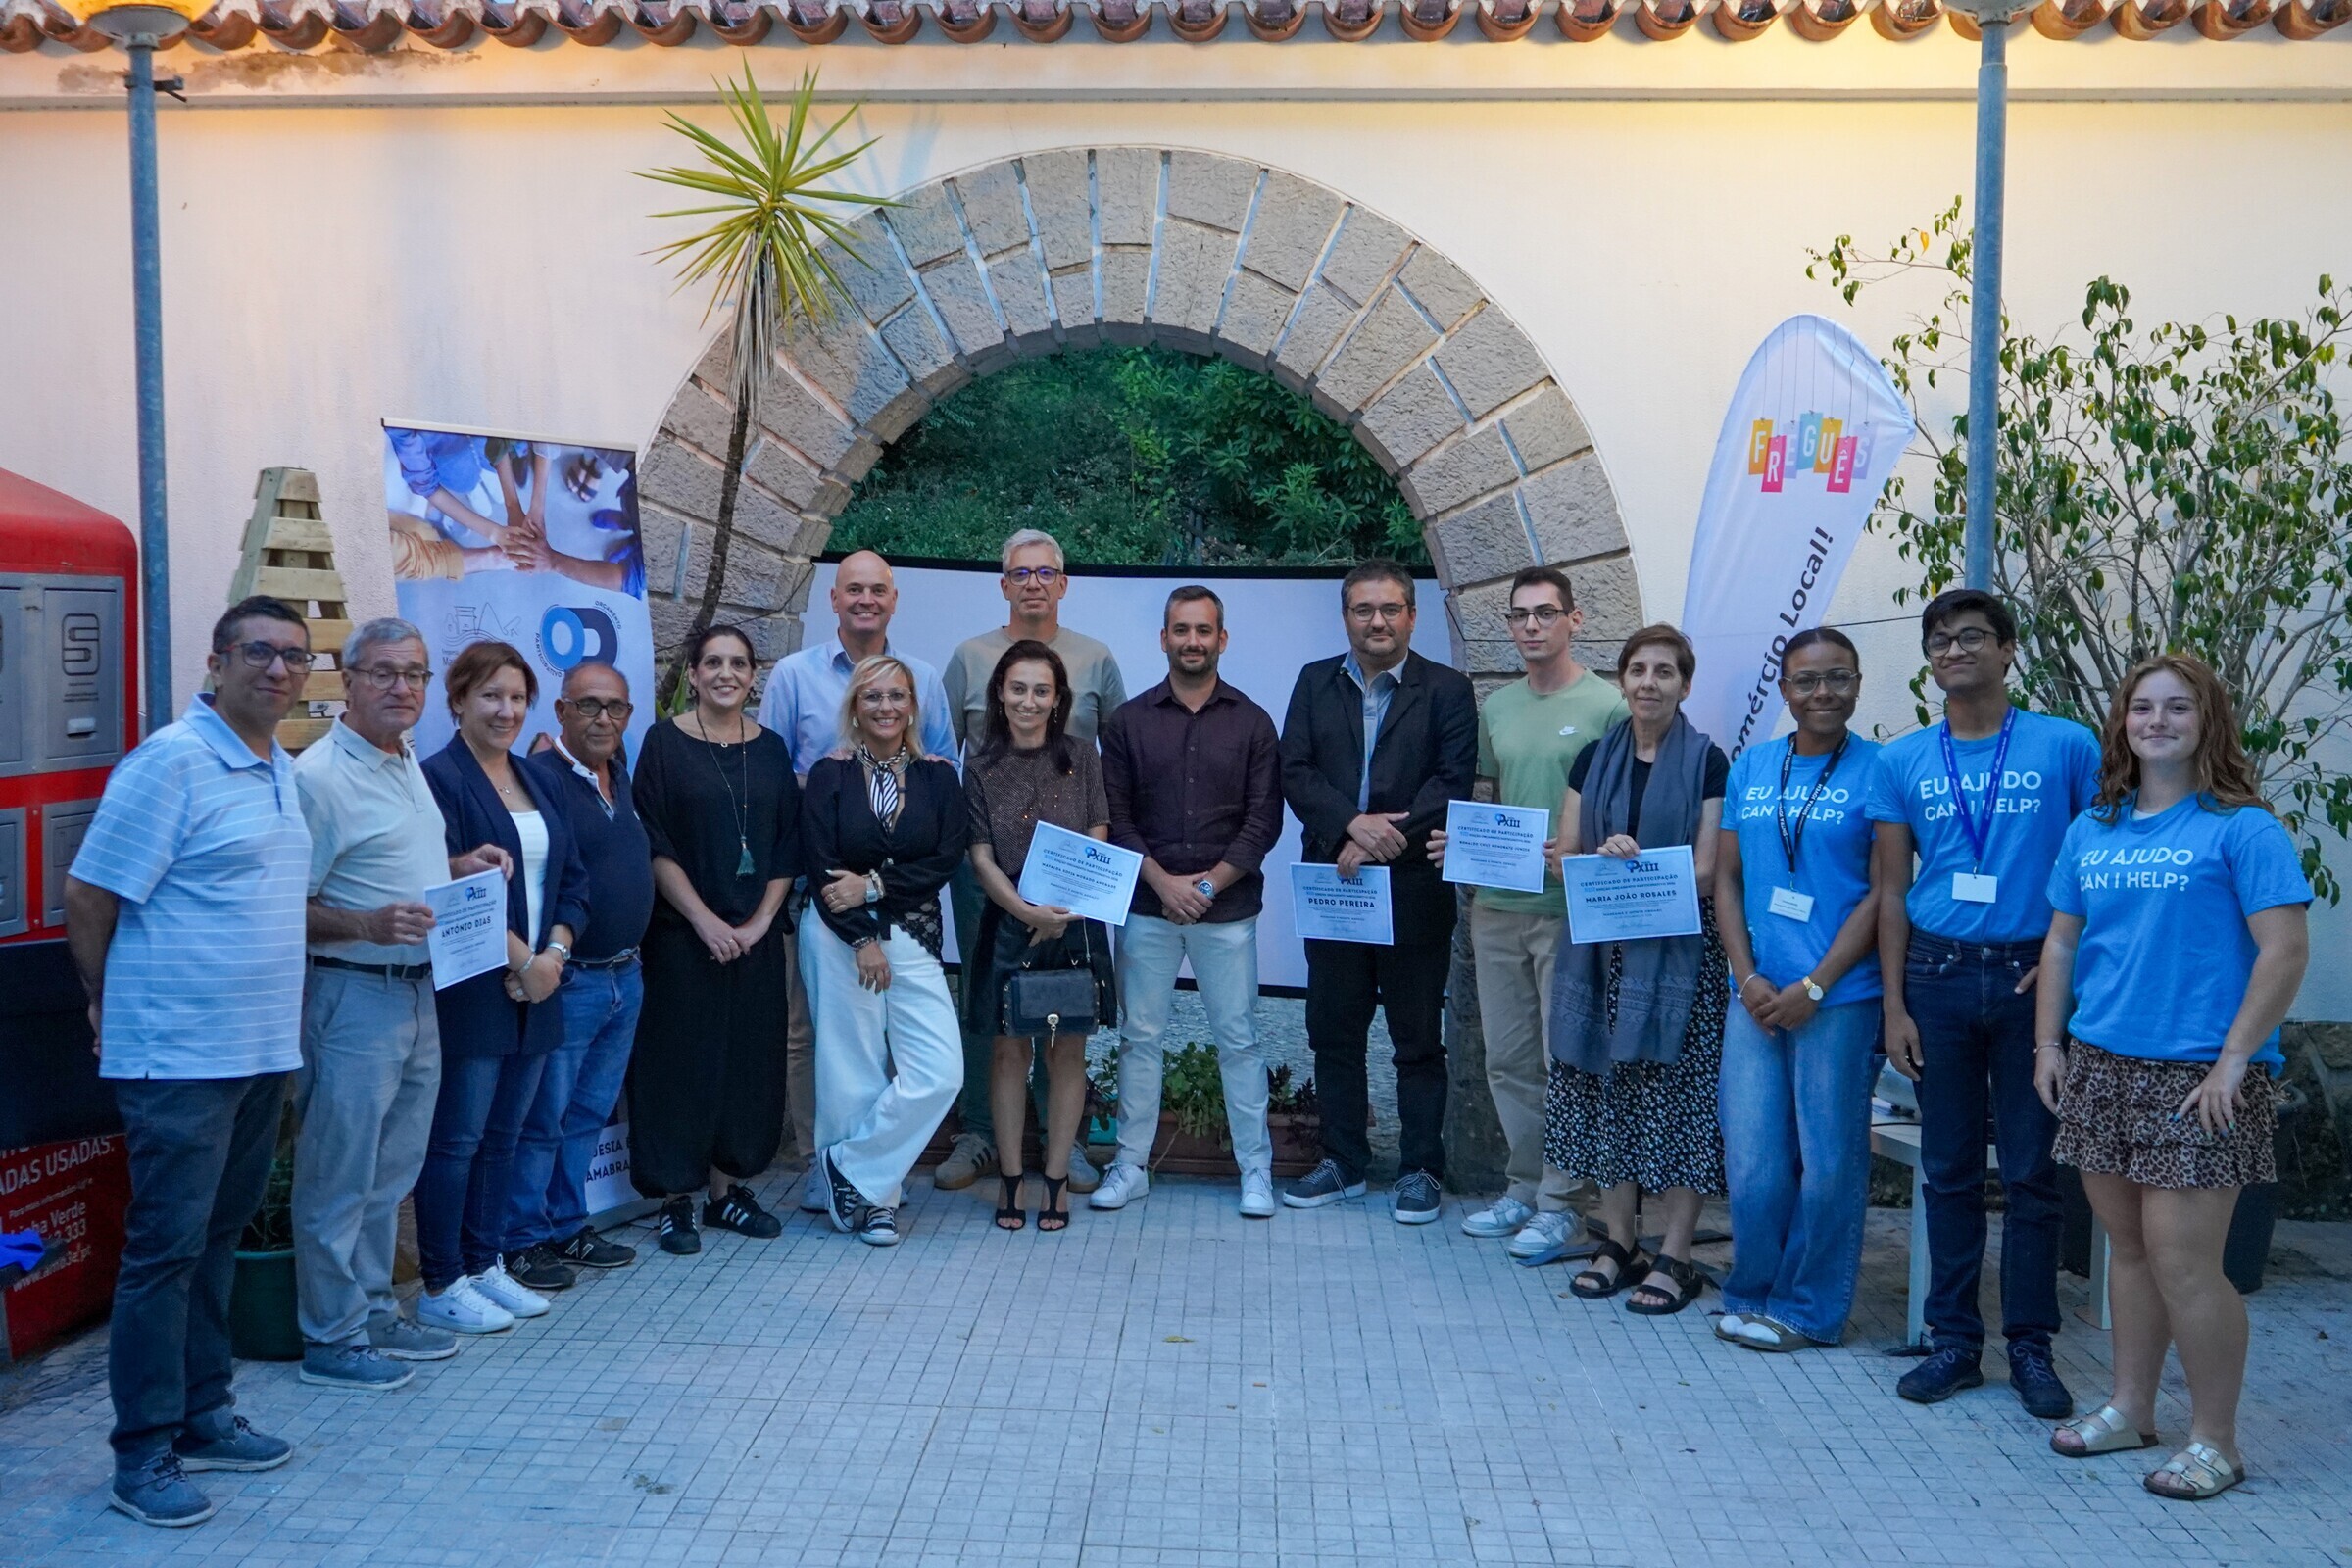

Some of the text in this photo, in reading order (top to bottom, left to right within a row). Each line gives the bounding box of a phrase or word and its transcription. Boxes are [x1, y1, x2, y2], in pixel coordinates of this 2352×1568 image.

[1731, 527, 1834, 762] omércio Local!
[1745, 786, 1773, 801] EU
[1919, 776, 1949, 800] EU
[1741, 805, 1775, 820] CAN
[1925, 801, 1960, 821] CAN
[1970, 799, 1976, 815] I
[2081, 847, 2194, 867] EU AJUDO
[2080, 871, 2189, 892] CAN I HELP?
[1340, 899, 1375, 908] PEREIRA
[442, 922, 472, 938] ANTÓNIO
[475, 916, 491, 927] DIAS
[45, 1137, 115, 1176] USADAS.
[50, 1200, 86, 1227] Verde
